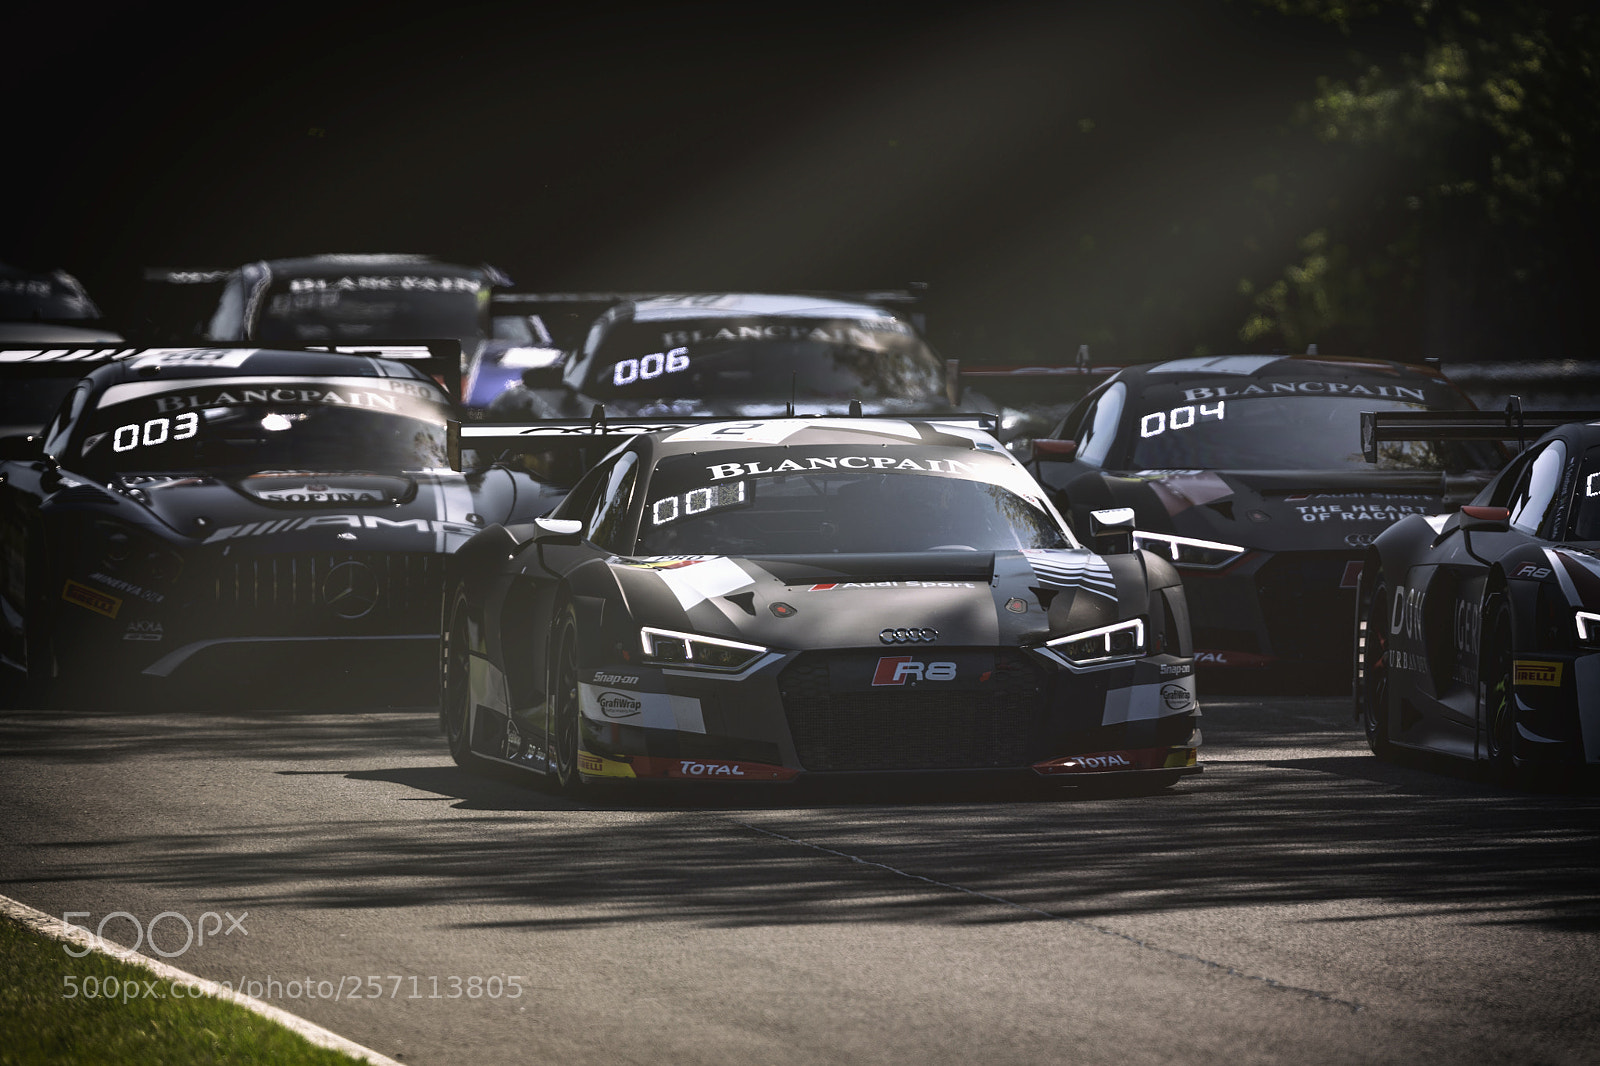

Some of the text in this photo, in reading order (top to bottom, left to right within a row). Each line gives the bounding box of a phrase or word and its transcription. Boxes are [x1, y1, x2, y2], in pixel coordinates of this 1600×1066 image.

[613, 346, 690, 386] 006
[1182, 381, 1425, 401] BLANCPAIN
[157, 388, 400, 413] BLANCPAIN
[1140, 401, 1224, 438] 004
[113, 412, 199, 452] 003
[711, 423, 764, 435] 2
[706, 456, 978, 481] BLANCPAIN
[267, 492, 372, 502] SOFINA
[1371, 493, 1433, 501] Sport
[1296, 504, 1428, 514] THE HEART
[1302, 511, 1426, 522] OF RACIN
[1517, 565, 1551, 579] R8
[905, 581, 976, 589] Sport
[1193, 652, 1227, 663] TAL
[892, 661, 957, 681] R8
[1160, 664, 1190, 676] Snap-on
[593, 671, 639, 685] Snap-on
[600, 698, 641, 711] GrafiWrap
[680, 761, 744, 775] TOTAL
[1072, 755, 1130, 769] TOTAL
